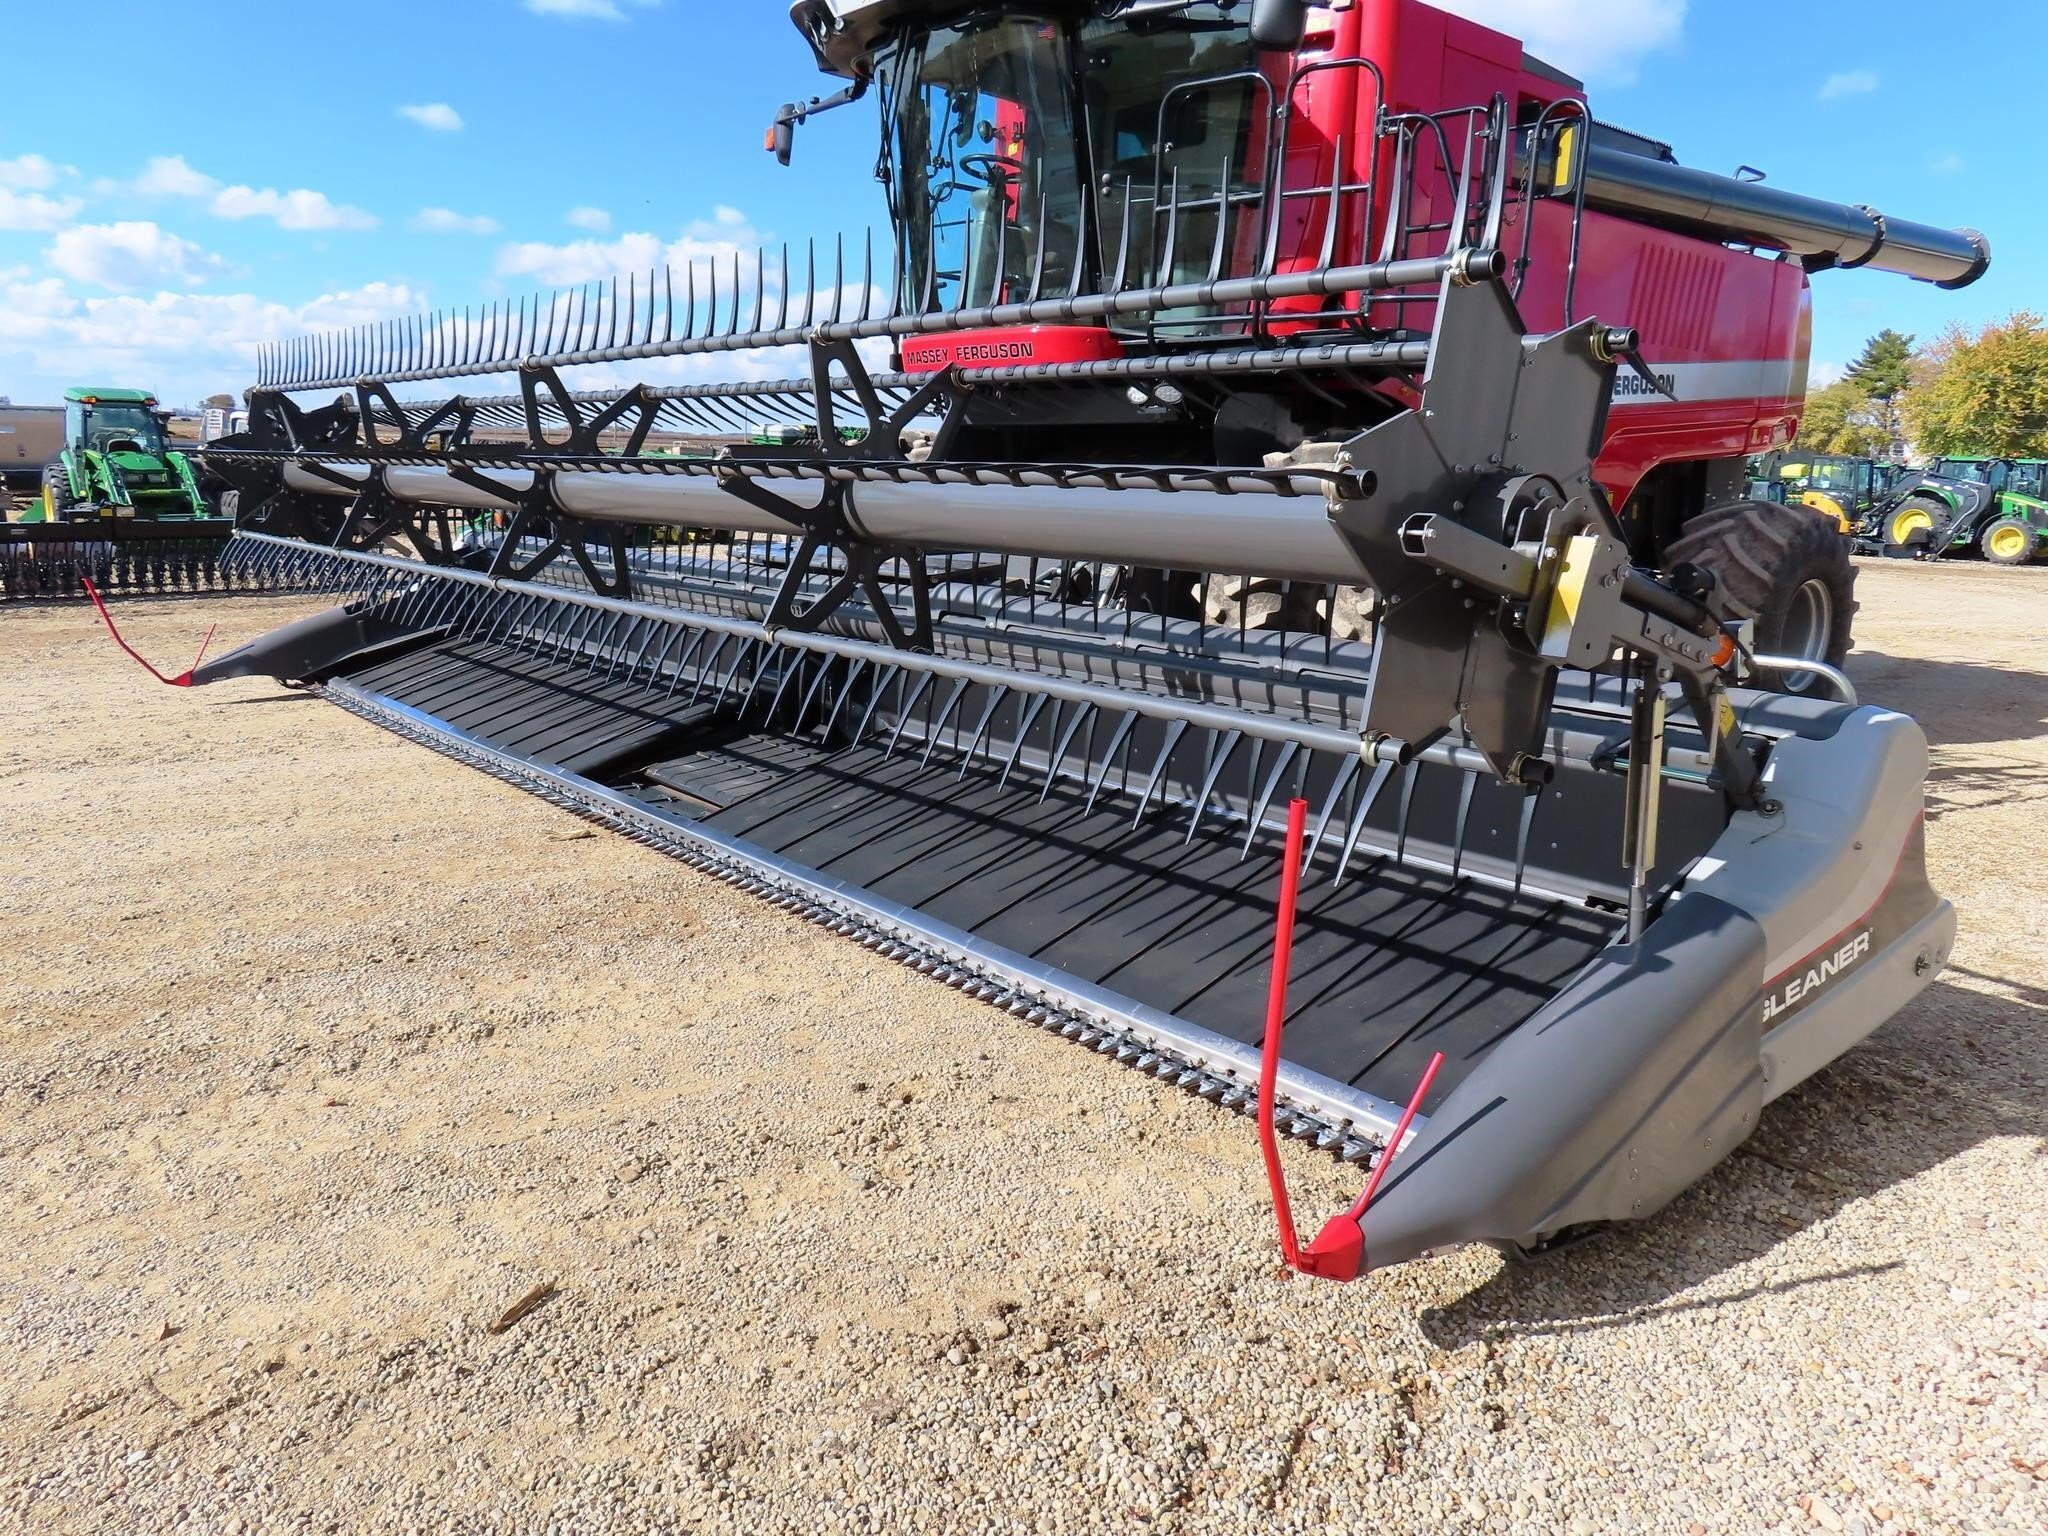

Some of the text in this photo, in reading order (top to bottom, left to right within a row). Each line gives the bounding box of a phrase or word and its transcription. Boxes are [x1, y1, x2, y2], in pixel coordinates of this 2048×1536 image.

[907, 342, 1033, 364] MASSEY FERGUSON
[1613, 374, 1675, 396] ERGUSON
